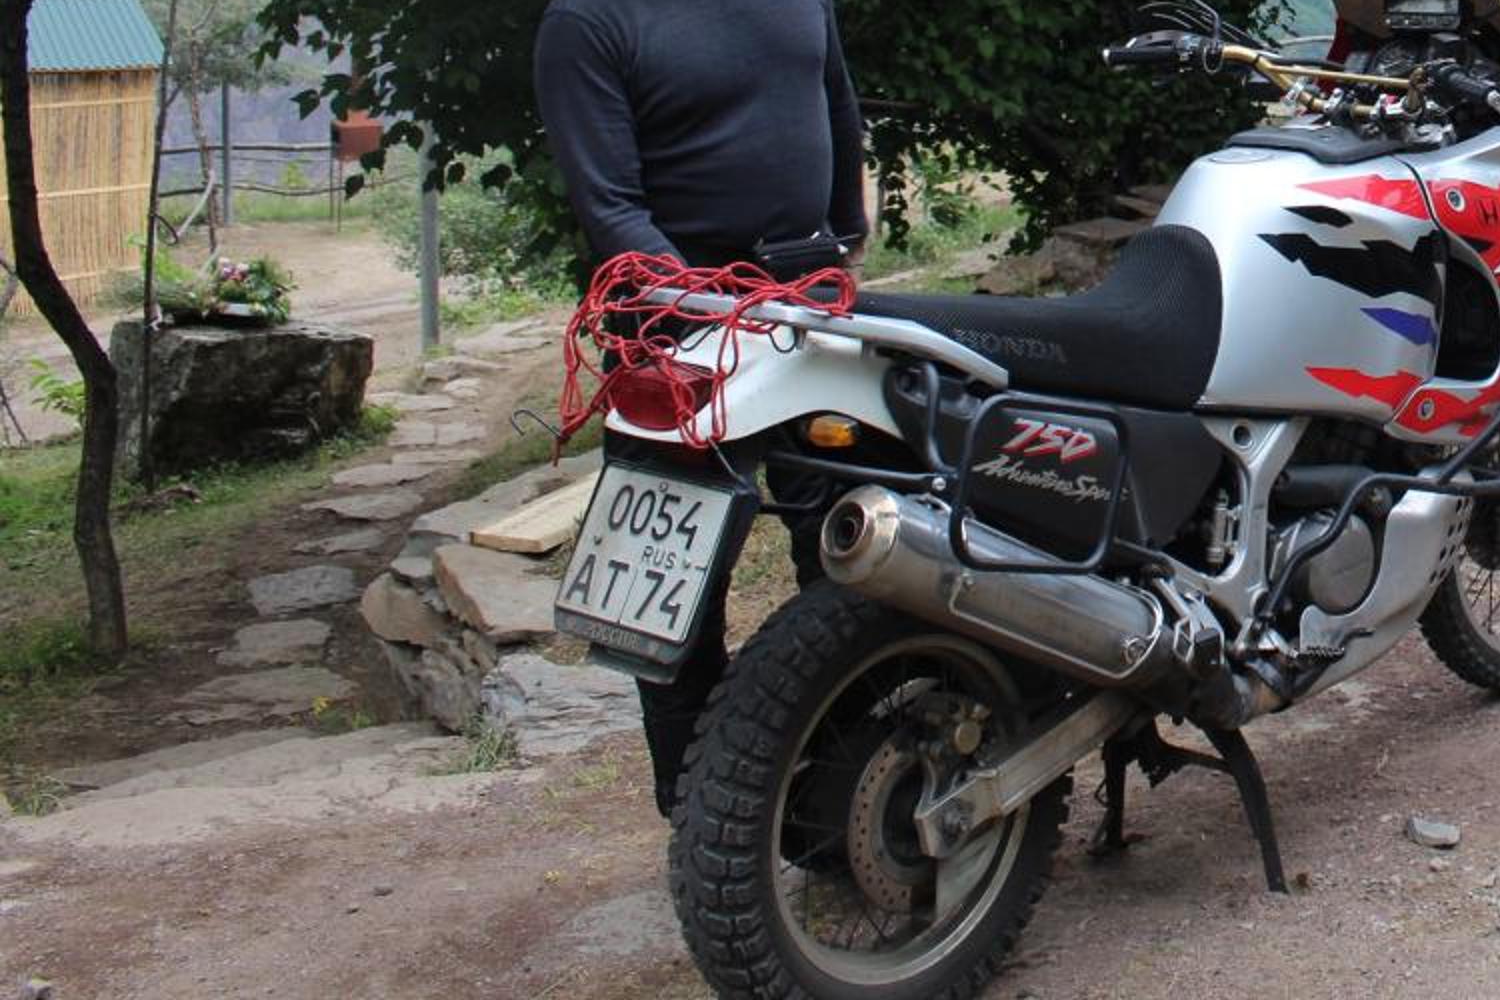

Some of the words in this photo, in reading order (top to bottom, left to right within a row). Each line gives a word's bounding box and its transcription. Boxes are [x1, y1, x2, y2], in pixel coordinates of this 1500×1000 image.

[608, 484, 702, 550] 0054
[640, 545, 677, 570] RUS
[634, 569, 686, 630] 74
